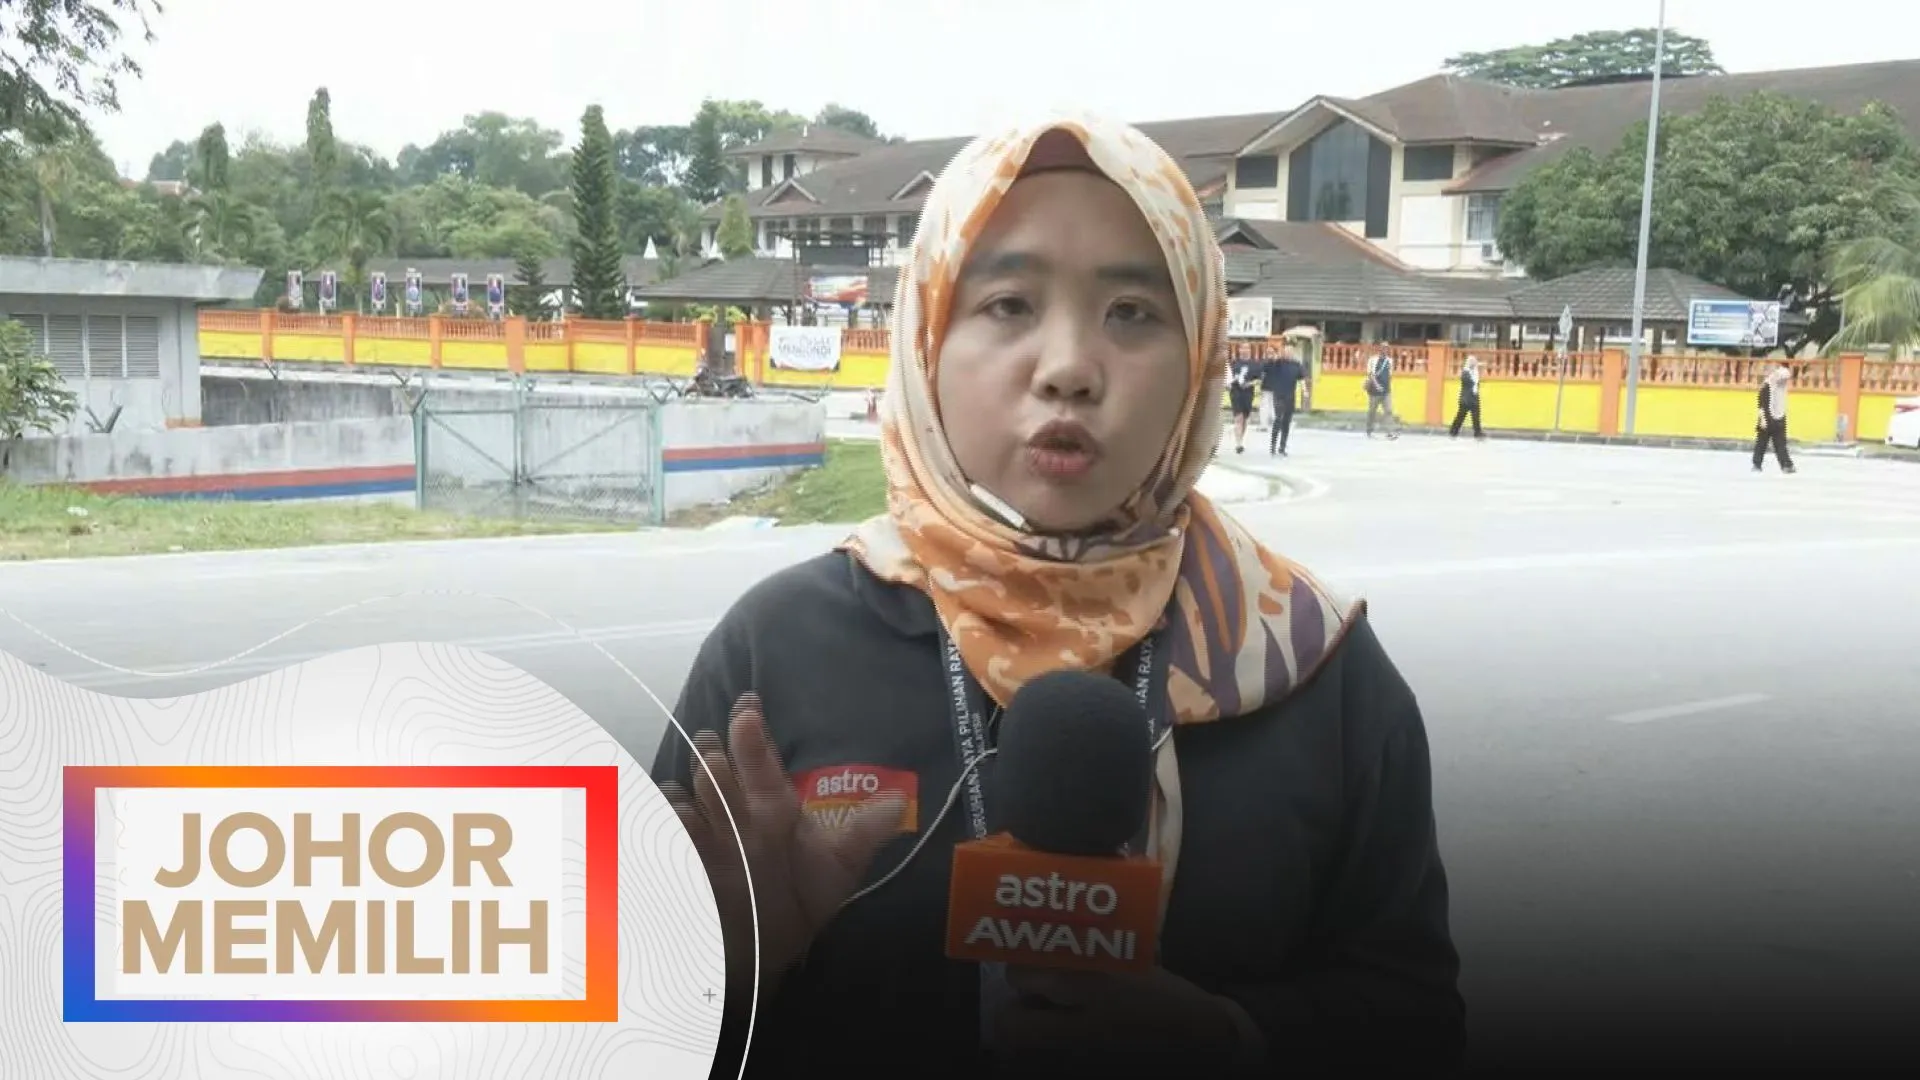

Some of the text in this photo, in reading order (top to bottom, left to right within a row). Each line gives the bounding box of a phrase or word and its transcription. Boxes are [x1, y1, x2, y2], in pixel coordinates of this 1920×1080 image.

[951, 675, 972, 735] PILIHAN
[816, 769, 879, 796] astro
[995, 872, 1119, 915] astro
[964, 916, 1137, 960] AWANI
